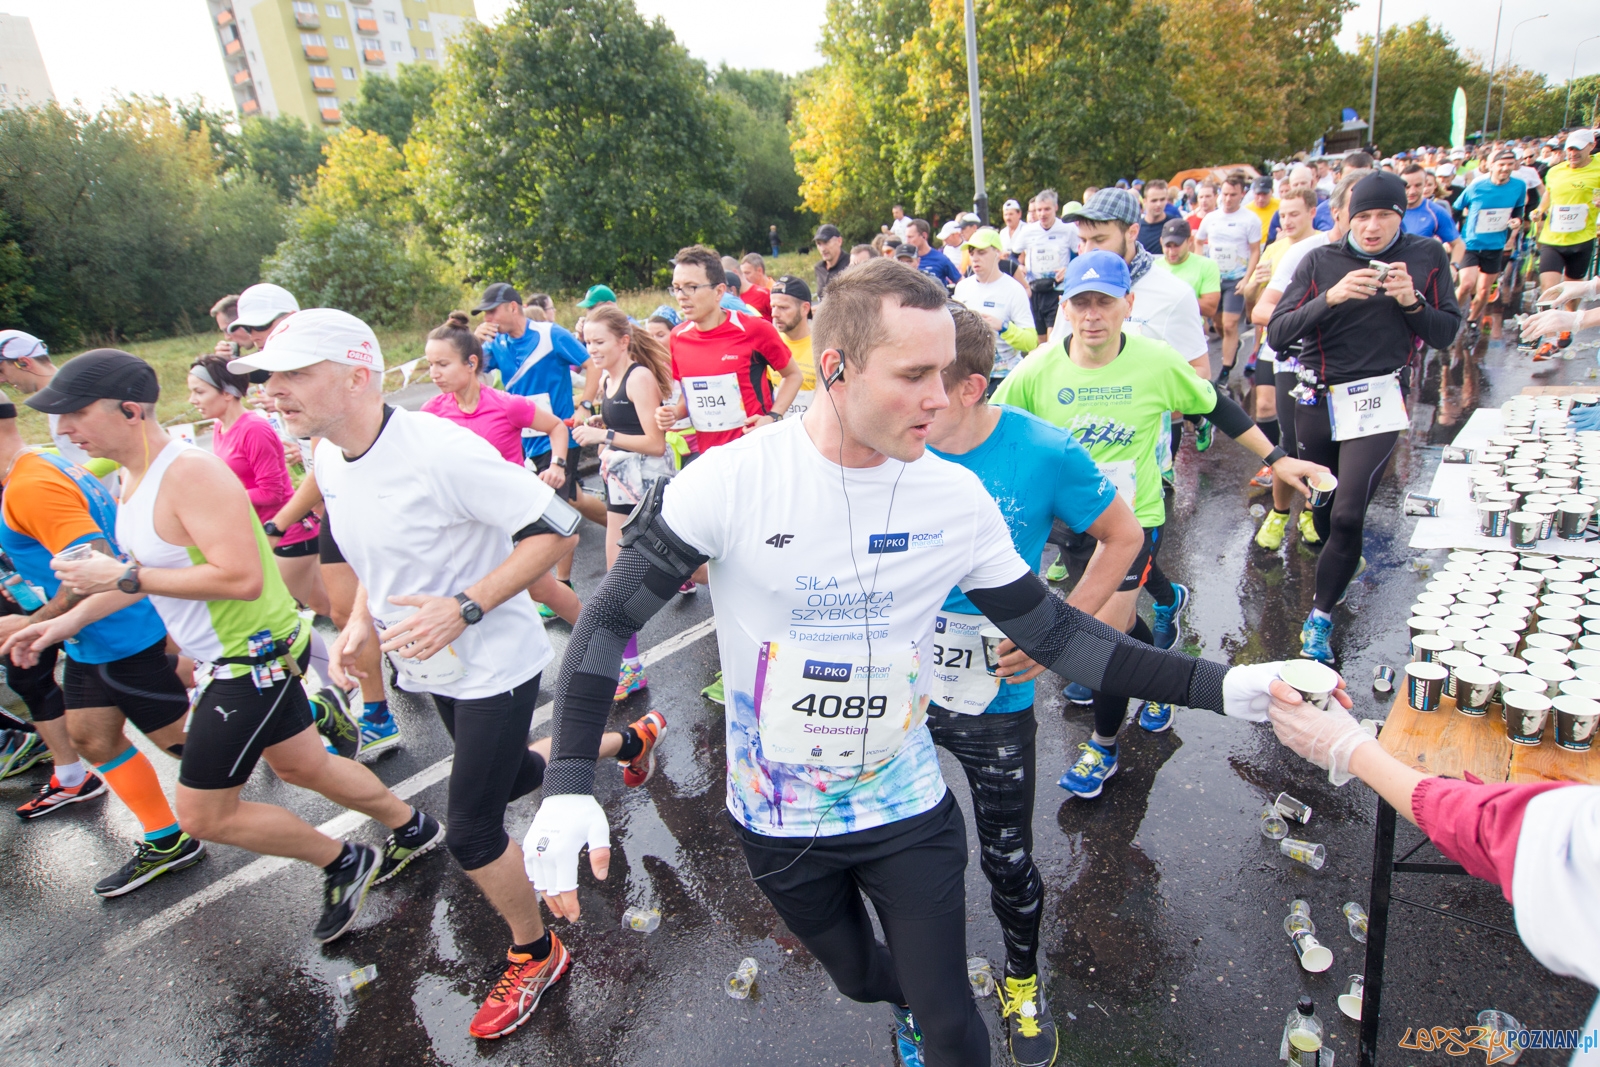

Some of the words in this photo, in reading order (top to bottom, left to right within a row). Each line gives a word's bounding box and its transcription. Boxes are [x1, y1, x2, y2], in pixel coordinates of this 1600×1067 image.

[1078, 385, 1133, 395] PRESS
[696, 395, 726, 408] 3194
[1077, 393, 1133, 402] SERVICE
[1353, 397, 1381, 412] 1218
[765, 533, 795, 548] 4F
[886, 538, 905, 548] PKO
[795, 575, 839, 590] SIŁA
[807, 591, 894, 607] ODWAGA
[791, 603, 892, 620] SZYBKOŚĆ
[789, 630, 797, 639] 9
[798, 631, 863, 642] października
[865, 629, 889, 639] 2016
[824, 666, 848, 677] PKO
[1415, 678, 1426, 710] 4MOVE
[791, 693, 888, 719] 4089
[803, 723, 869, 735] Sebastian
